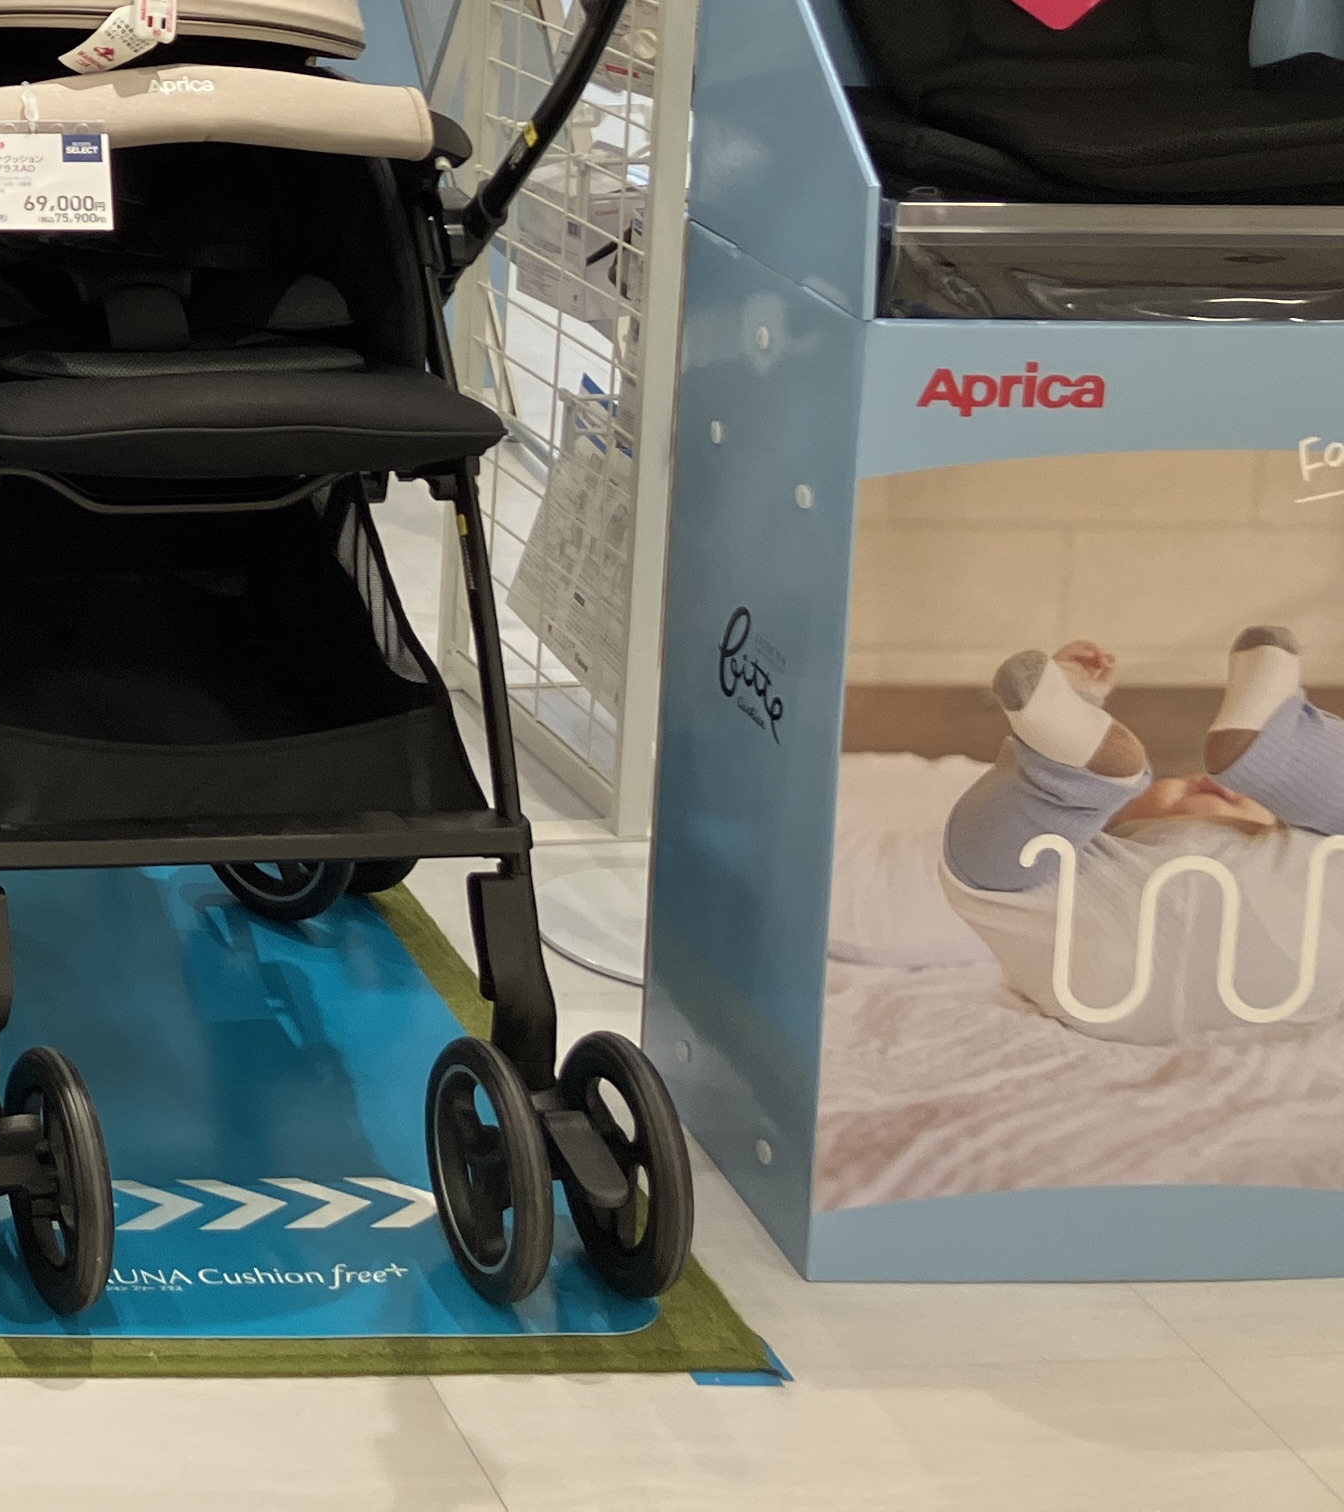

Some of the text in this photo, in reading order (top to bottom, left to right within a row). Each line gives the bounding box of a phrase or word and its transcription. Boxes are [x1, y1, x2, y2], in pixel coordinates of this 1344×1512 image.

[148, 76, 215, 95] Aprica
[66, 146, 98, 154] SELECT
[23, 195, 105, 212] 69,000円
[916, 361, 1105, 417] Aprica
[198, 1268, 324, 1285] Cushion
